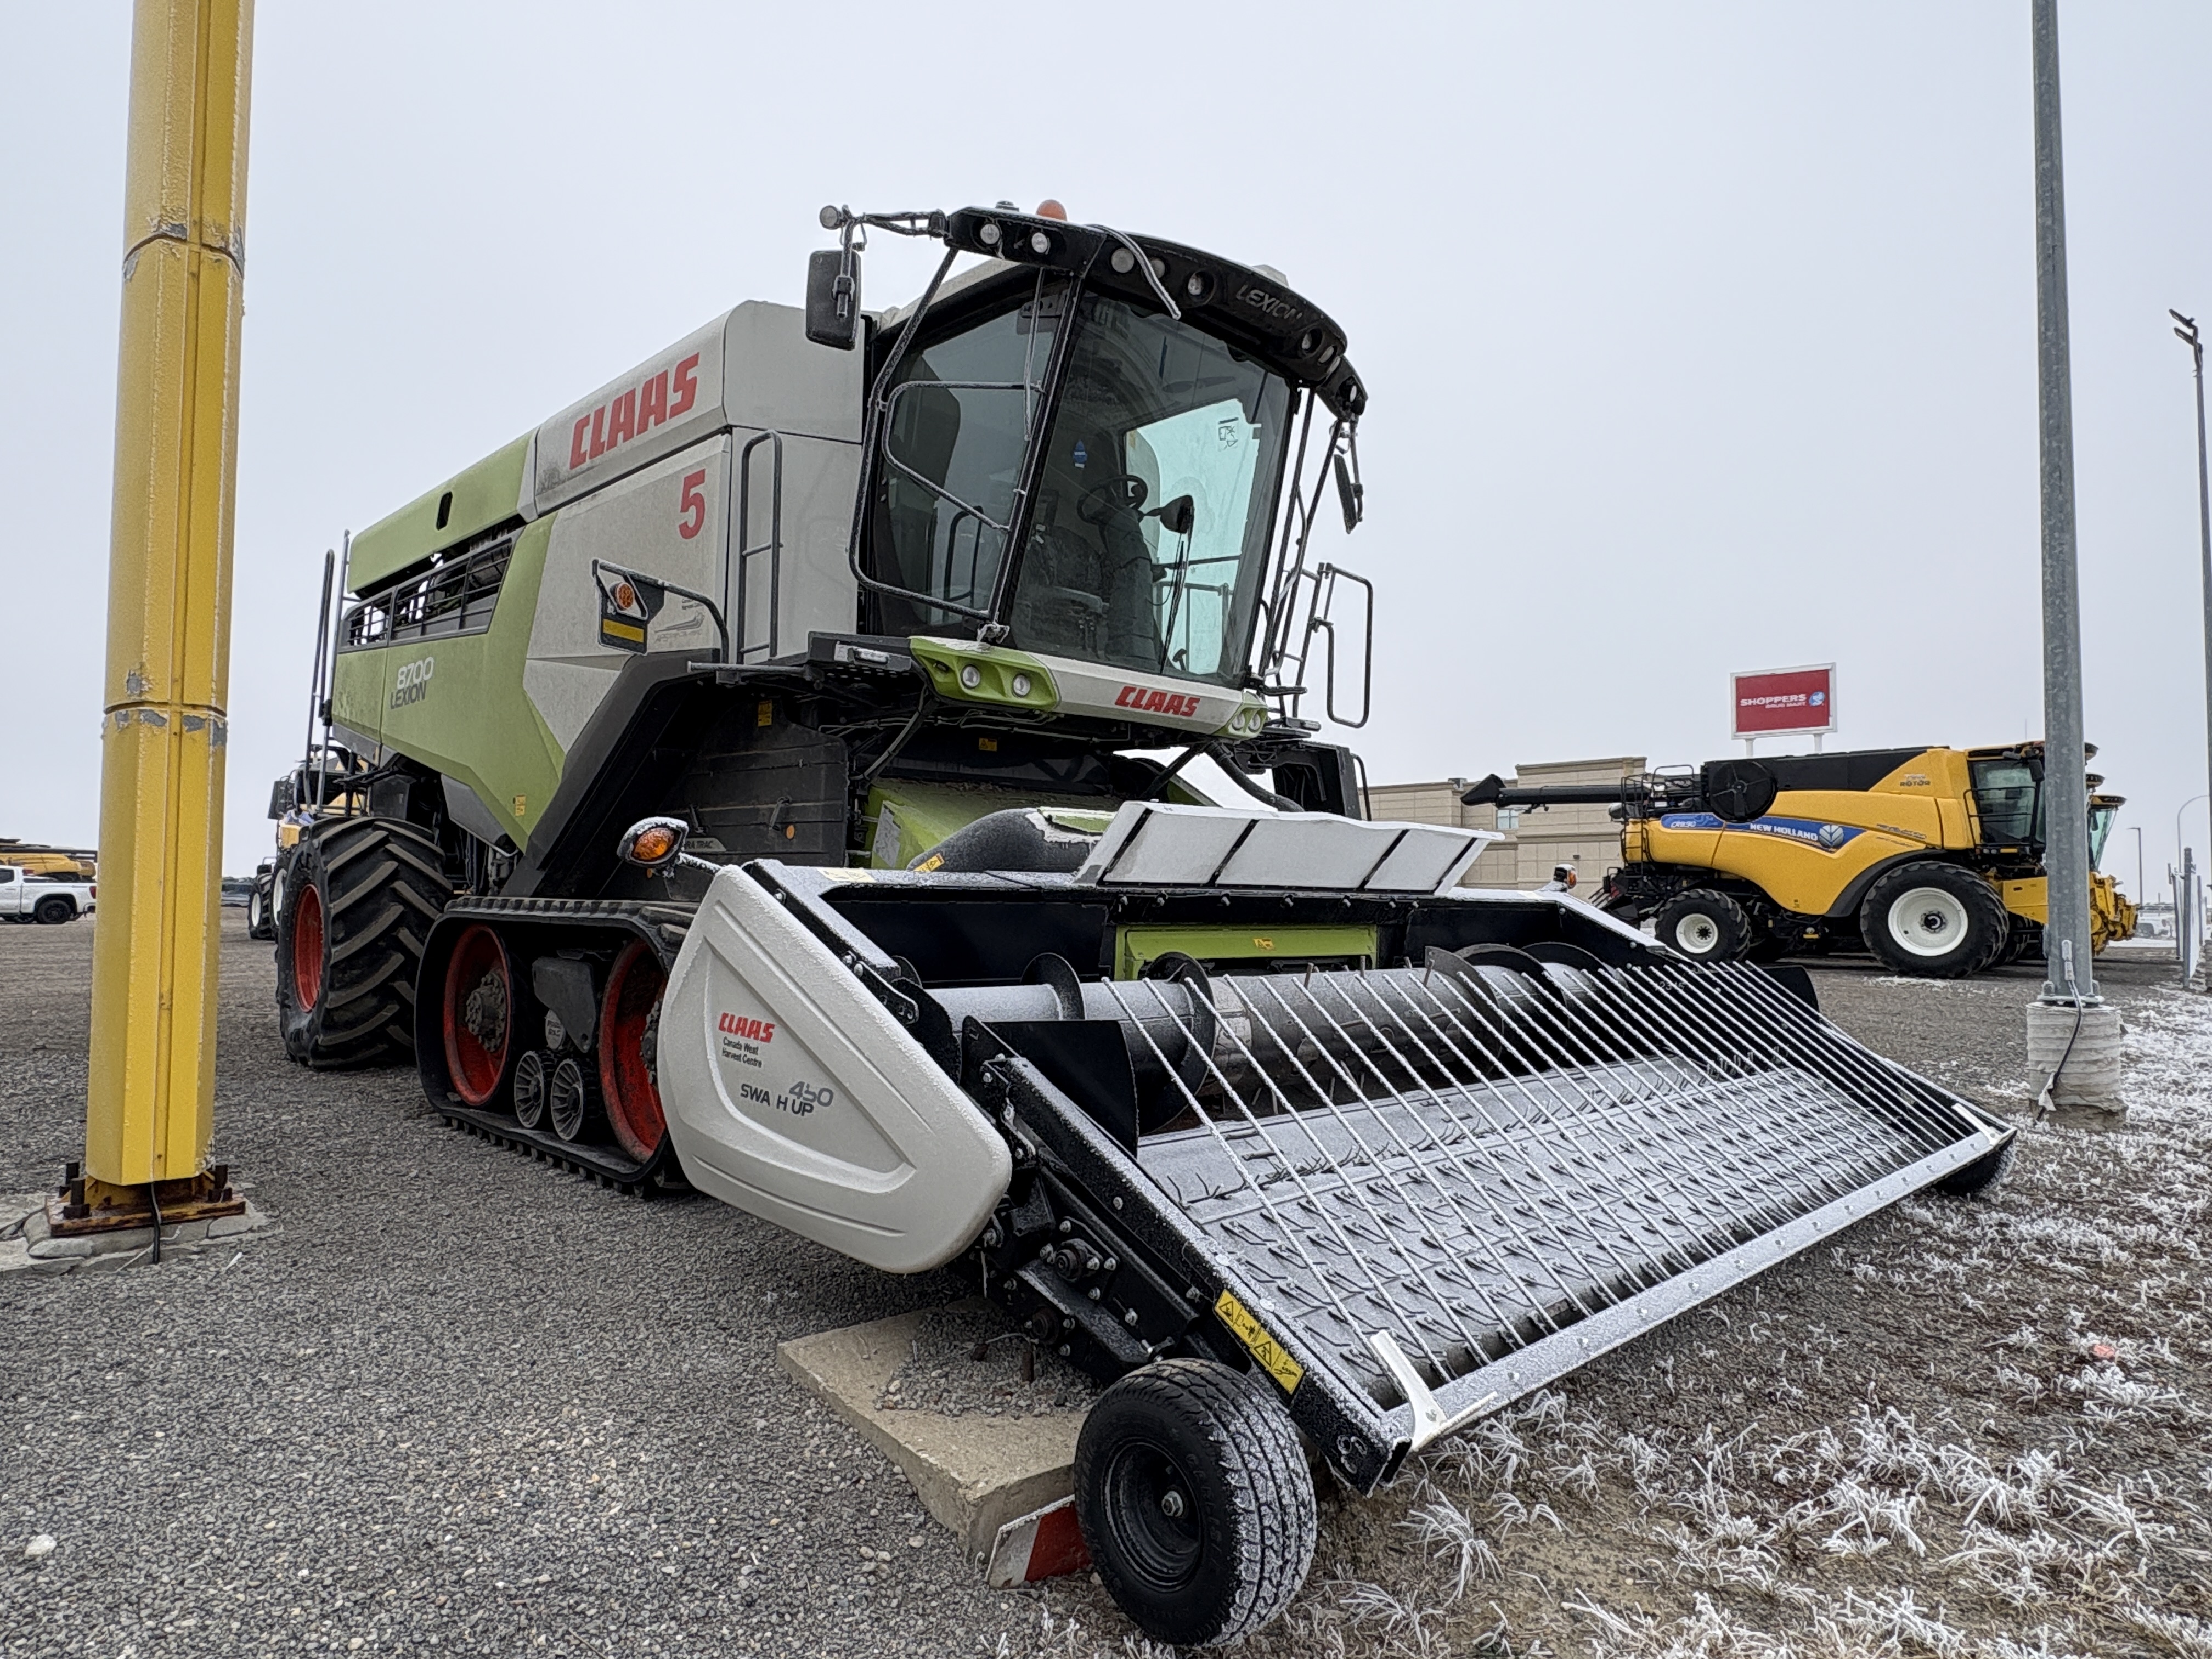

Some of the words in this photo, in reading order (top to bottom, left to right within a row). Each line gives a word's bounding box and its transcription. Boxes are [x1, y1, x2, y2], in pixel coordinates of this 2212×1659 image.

[1235, 284, 1303, 320] LEXION
[569, 352, 700, 470] CLAAS
[679, 469, 706, 540] 5
[397, 656, 435, 690] 8700
[390, 680, 427, 710] LEXION
[1114, 685, 1201, 718] CLAAS
[1740, 693, 1807, 707] SHOPPERS
[1749, 823, 1773, 833] NEW
[1773, 825, 1818, 842] HOLLAND
[718, 1012, 776, 1043] CLAAS
[723, 1036, 743, 1051] Canada
[743, 1042, 759, 1056] West
[742, 1053, 763, 1069] Centre
[788, 1081, 834, 1108] 450
